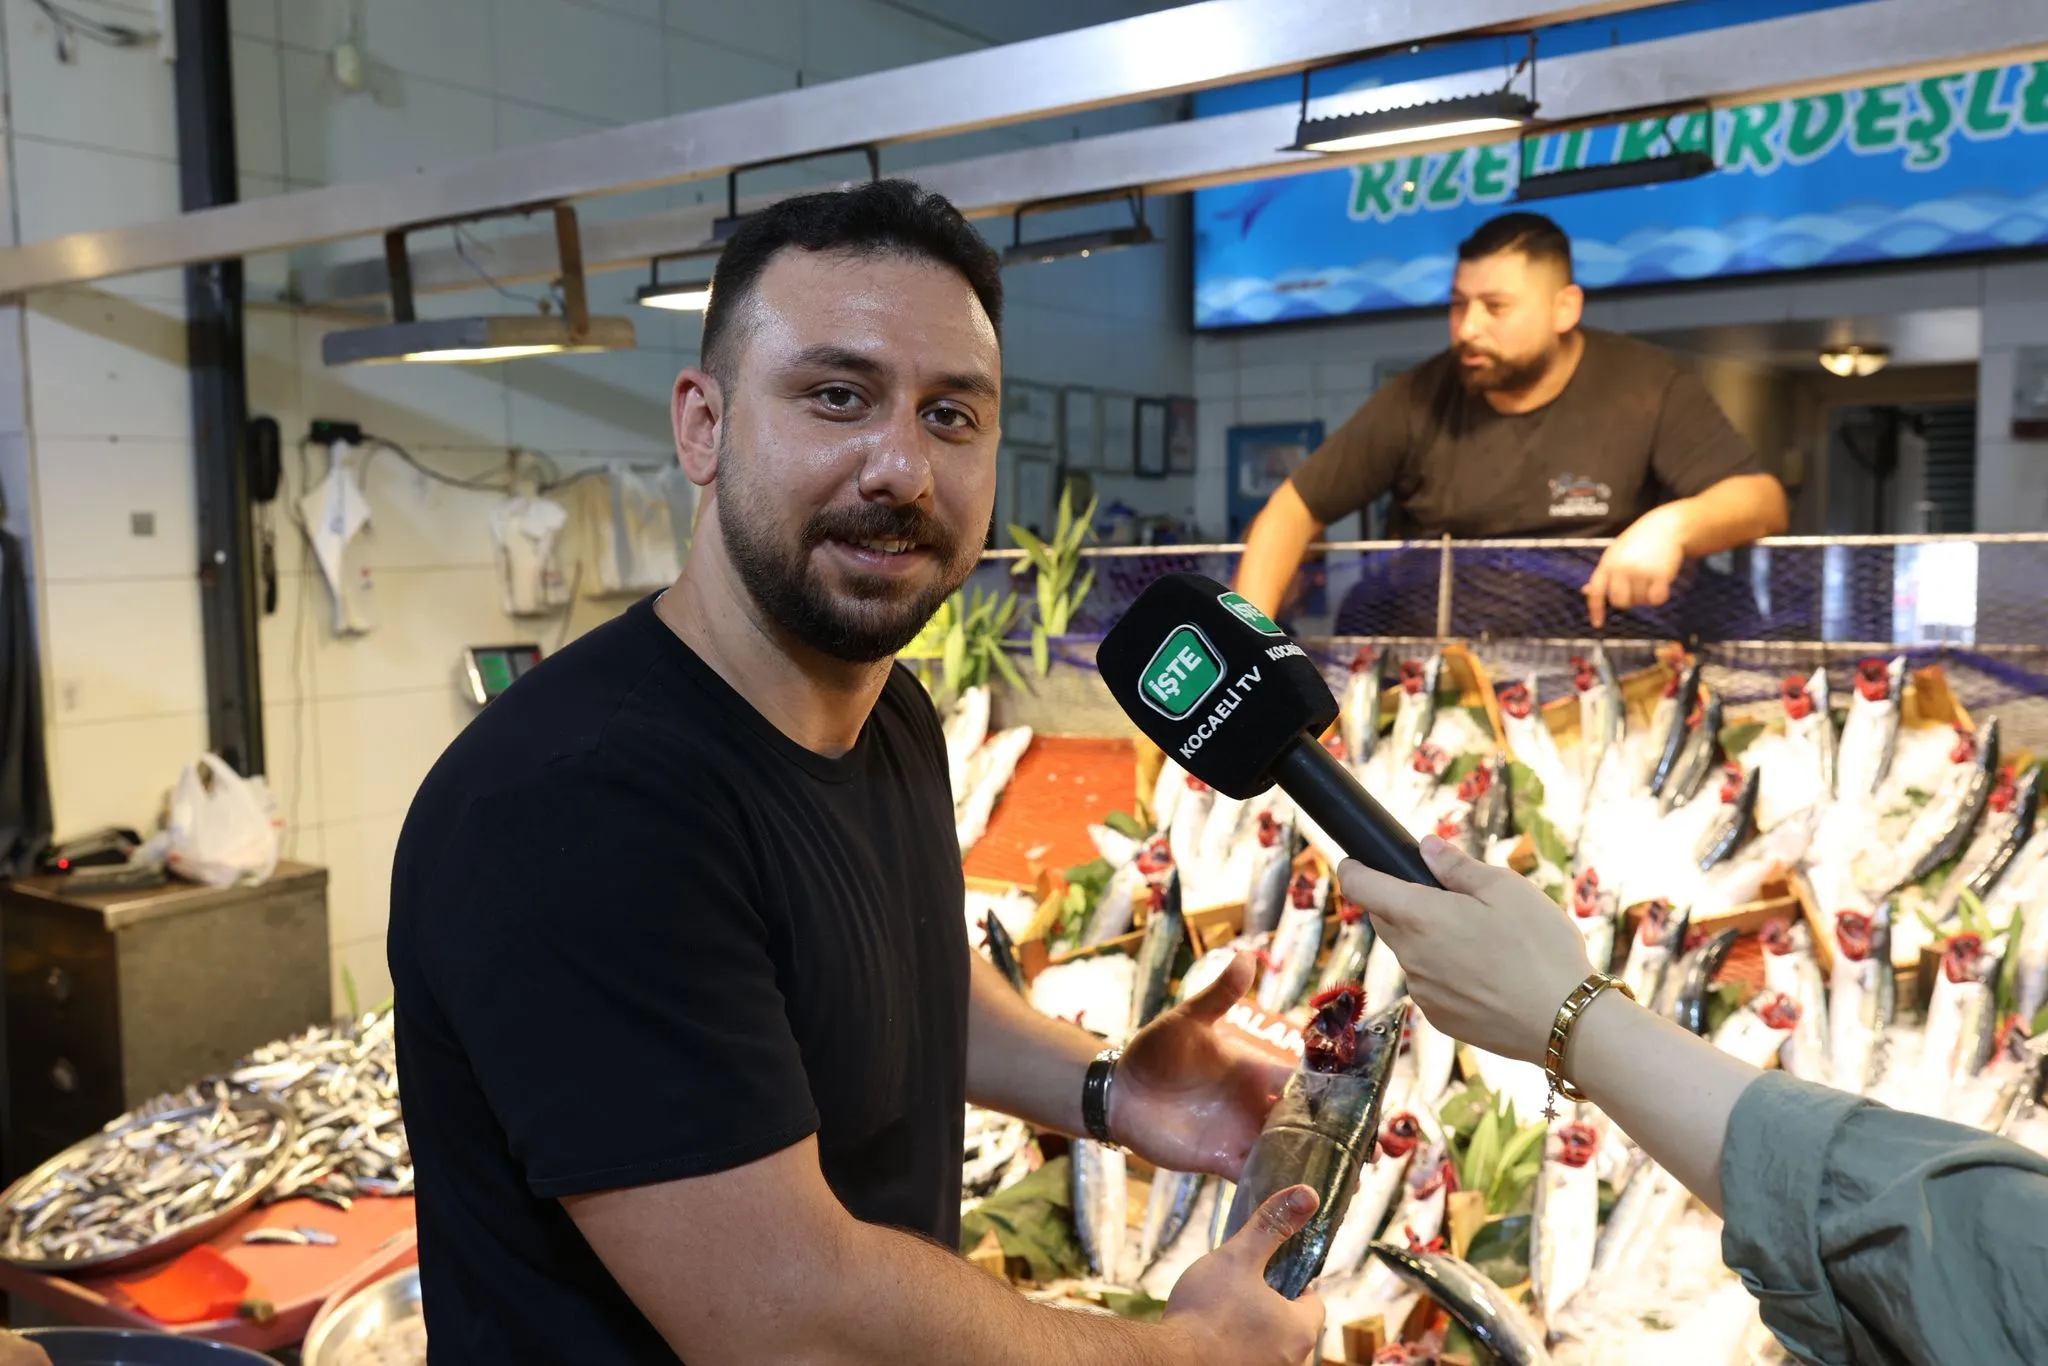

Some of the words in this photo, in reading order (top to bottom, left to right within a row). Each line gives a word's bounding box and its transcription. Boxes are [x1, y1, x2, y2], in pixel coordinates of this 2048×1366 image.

[1147, 645, 1203, 702] İŞTE
[1178, 687, 1243, 760] KOCAELİ
[1236, 665, 1263, 692] TV
